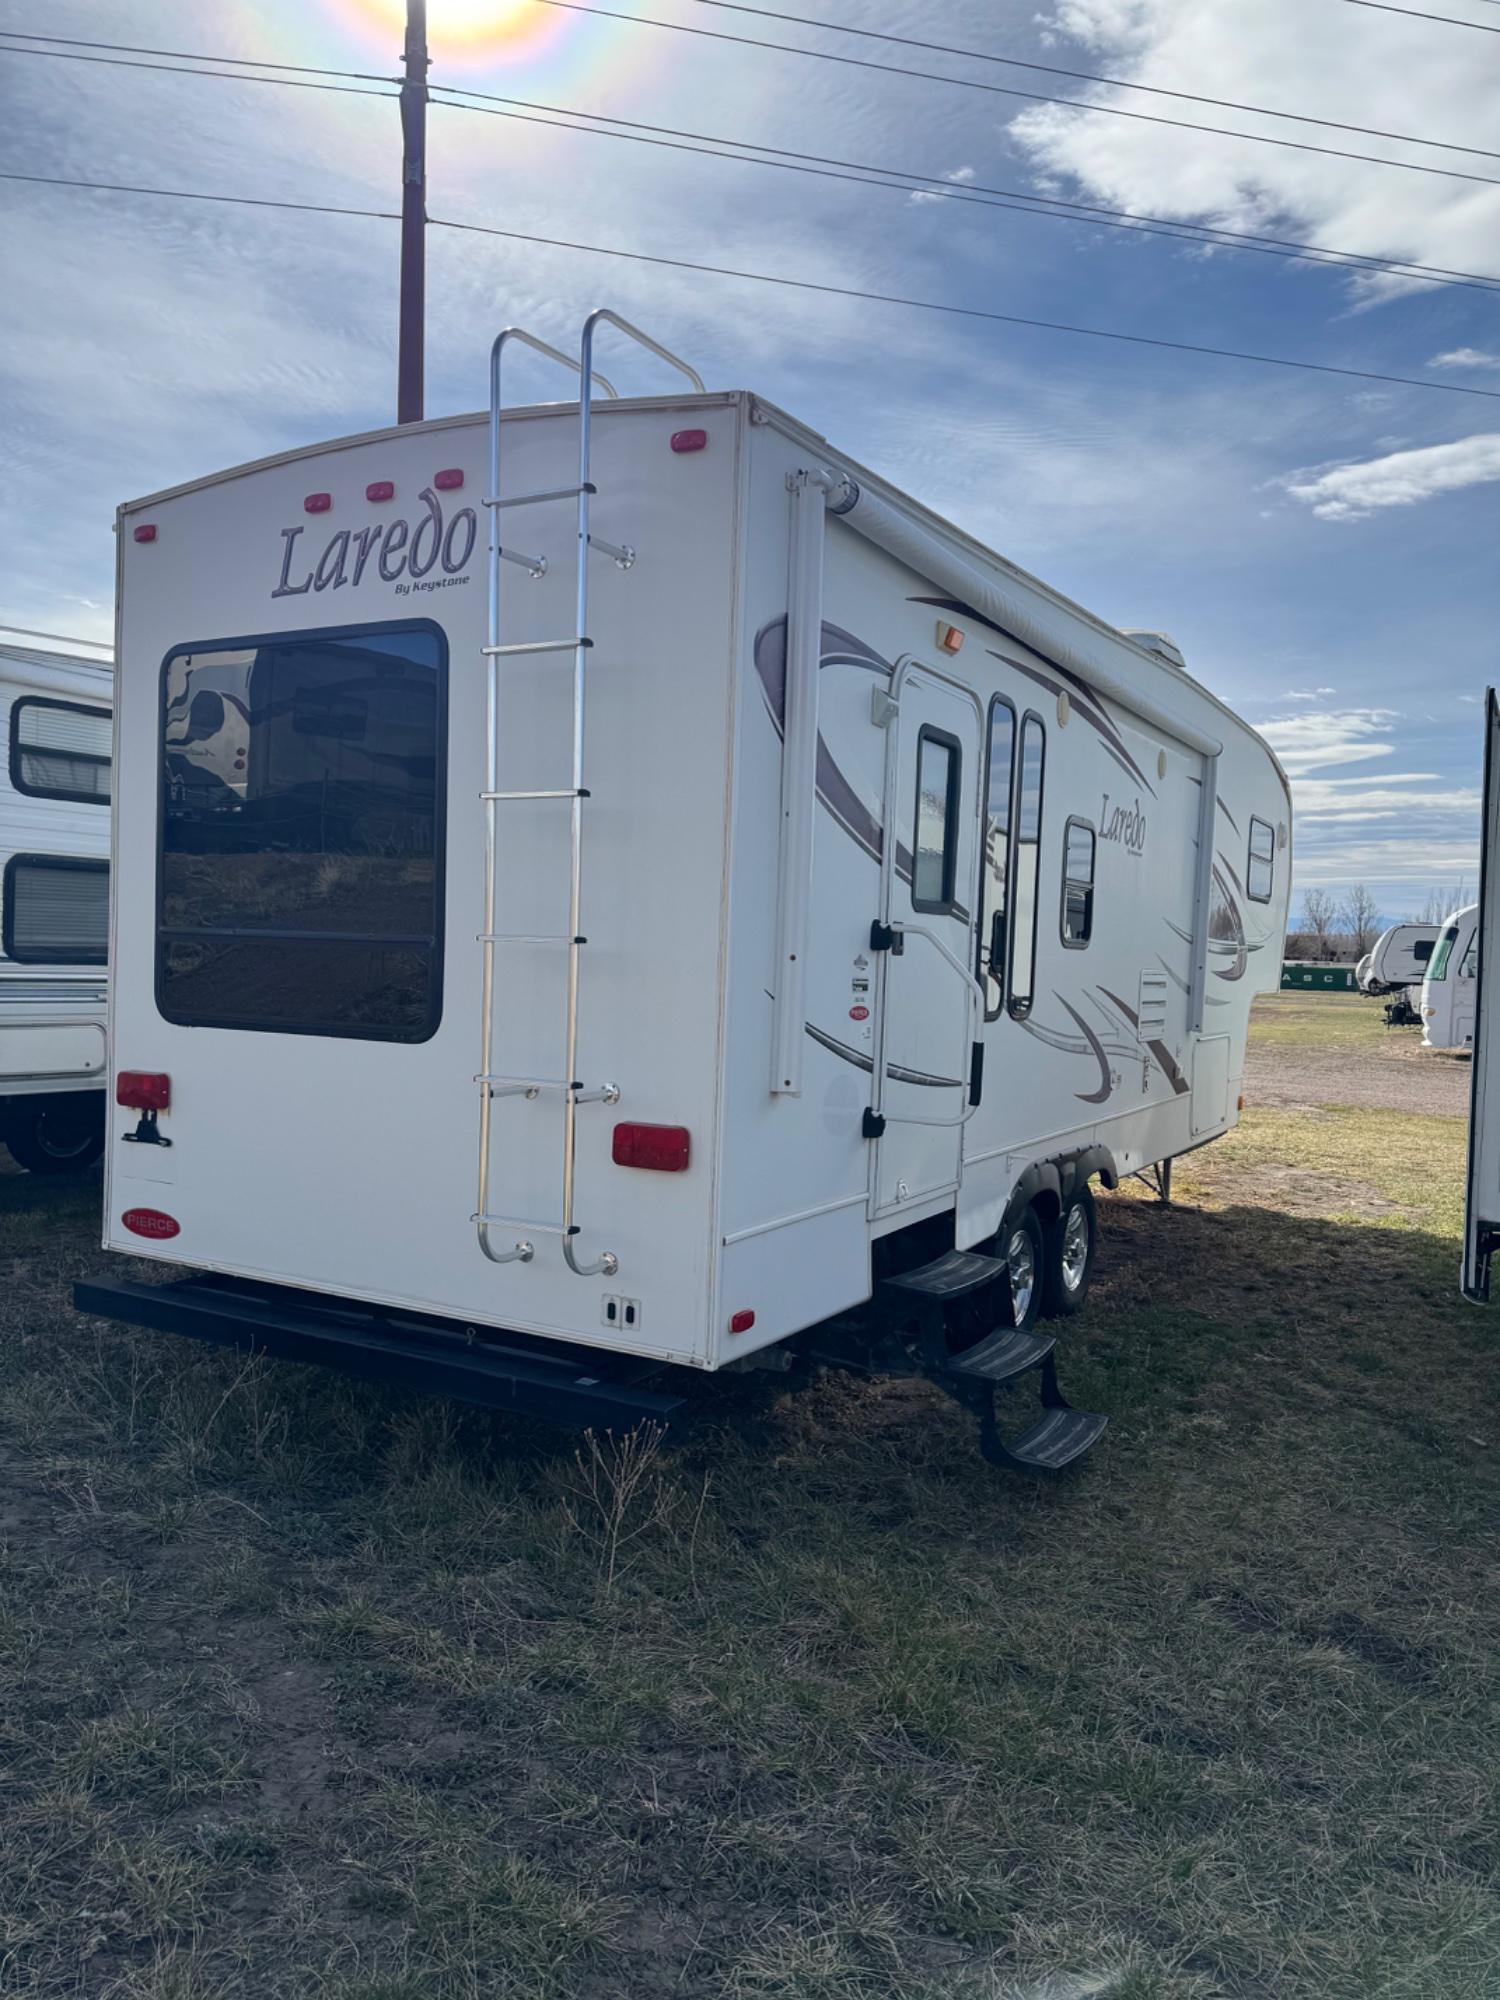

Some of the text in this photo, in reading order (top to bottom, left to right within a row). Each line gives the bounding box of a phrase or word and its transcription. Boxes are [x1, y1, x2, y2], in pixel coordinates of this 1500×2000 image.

[271, 487, 477, 598] Laredo
[394, 576, 470, 596] By Keystone
[1098, 793, 1146, 850] Laredo
[127, 1214, 175, 1232] PIERCE
